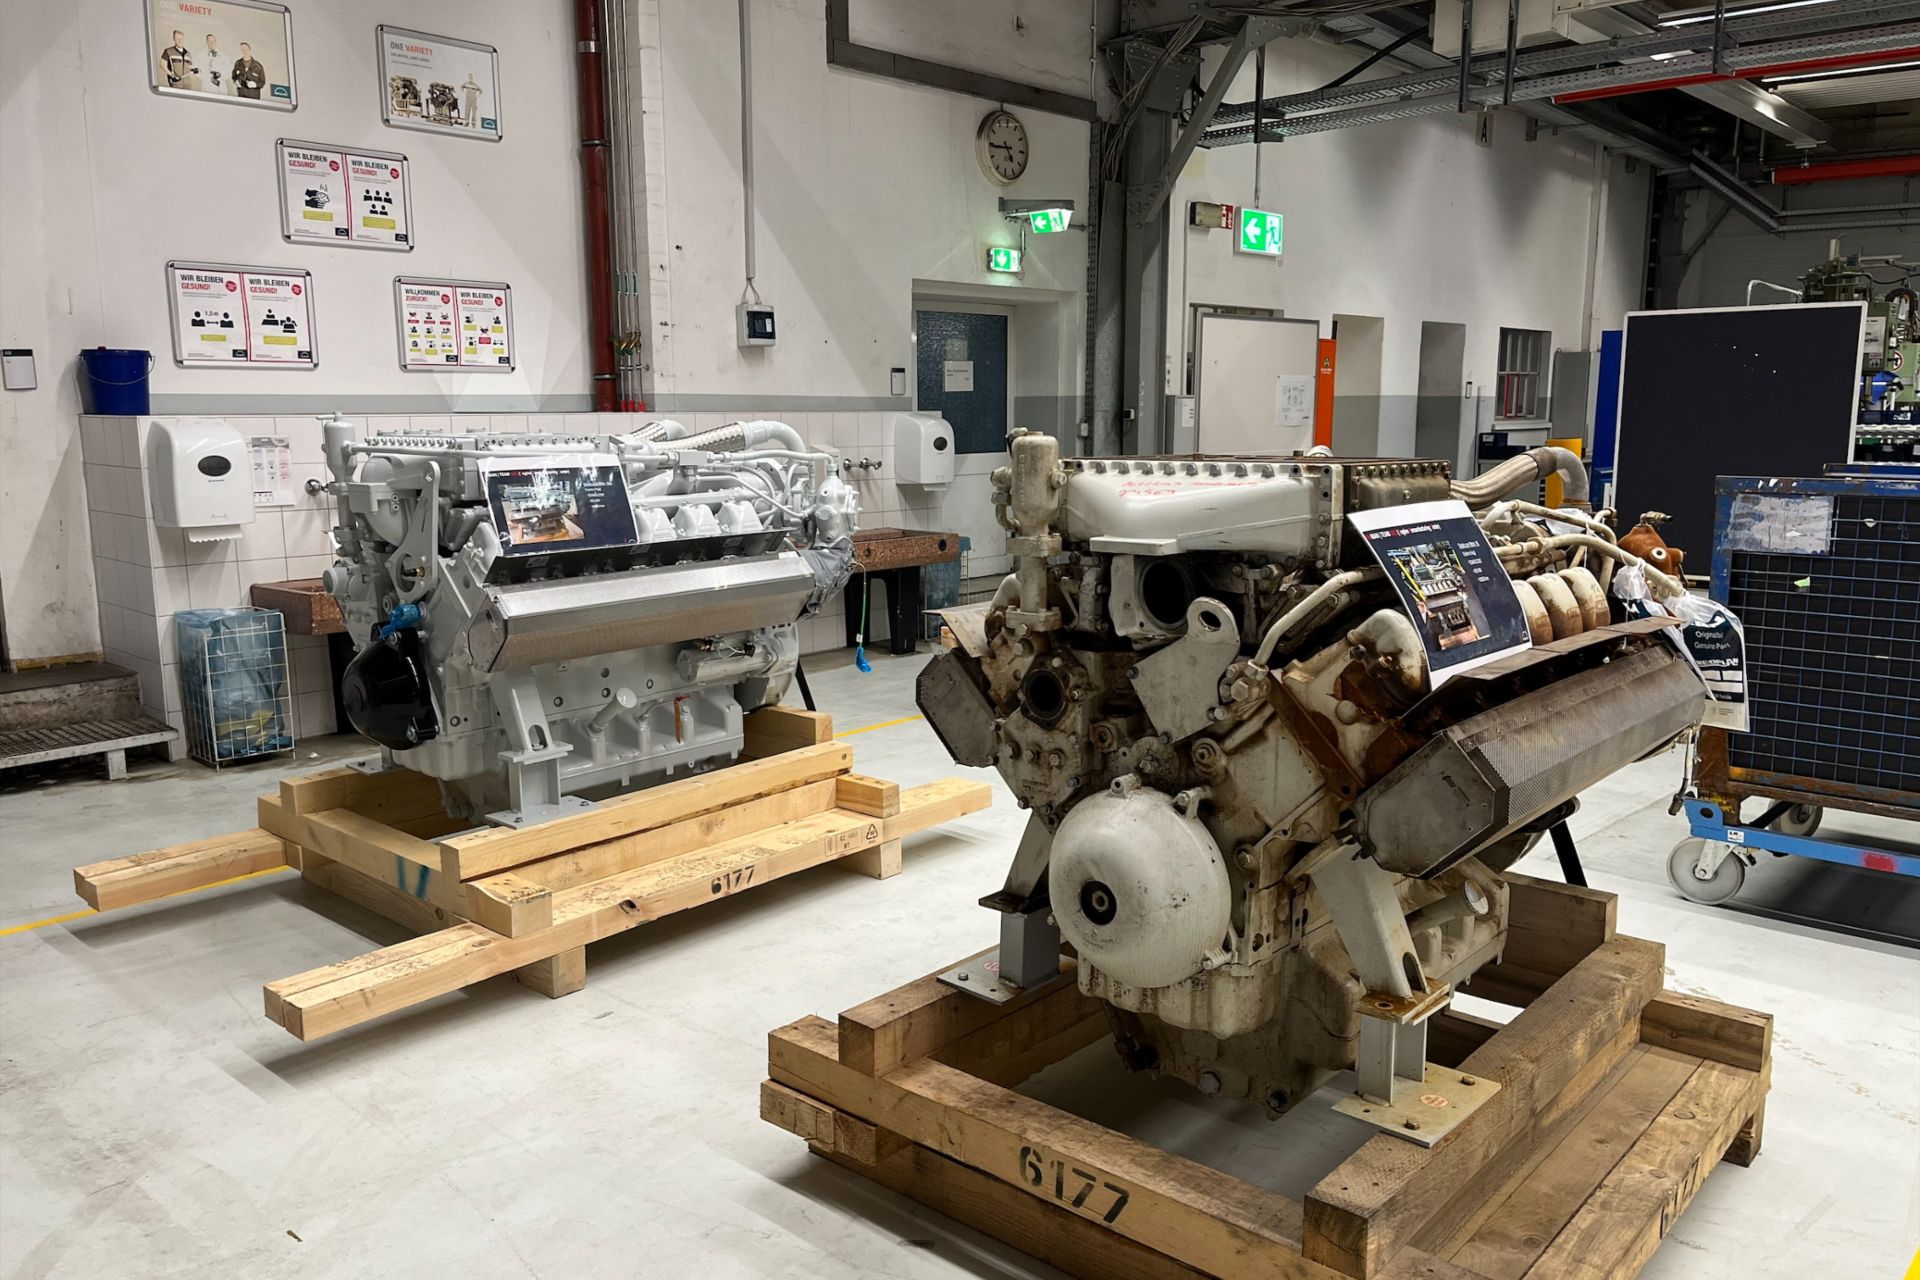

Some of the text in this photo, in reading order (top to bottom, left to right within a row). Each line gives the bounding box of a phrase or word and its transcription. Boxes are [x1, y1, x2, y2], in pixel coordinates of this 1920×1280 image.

[179, 3, 213, 16] VARIETY
[390, 41, 433, 56] ONE VARIETY
[1480, 116, 1488, 143] A
[288, 152, 328, 162] WIR BLEIBEN
[364, 161, 389, 170] BLEIBEN
[180, 274, 224, 284] WIR BLEIBEN
[249, 278, 290, 287] WIR BLEIBEN
[405, 288, 440, 297] WILLKOMMEN
[472, 292, 494, 300] BLEIBEN
[711, 864, 755, 895] 6177
[1020, 1145, 1130, 1224] 6177
